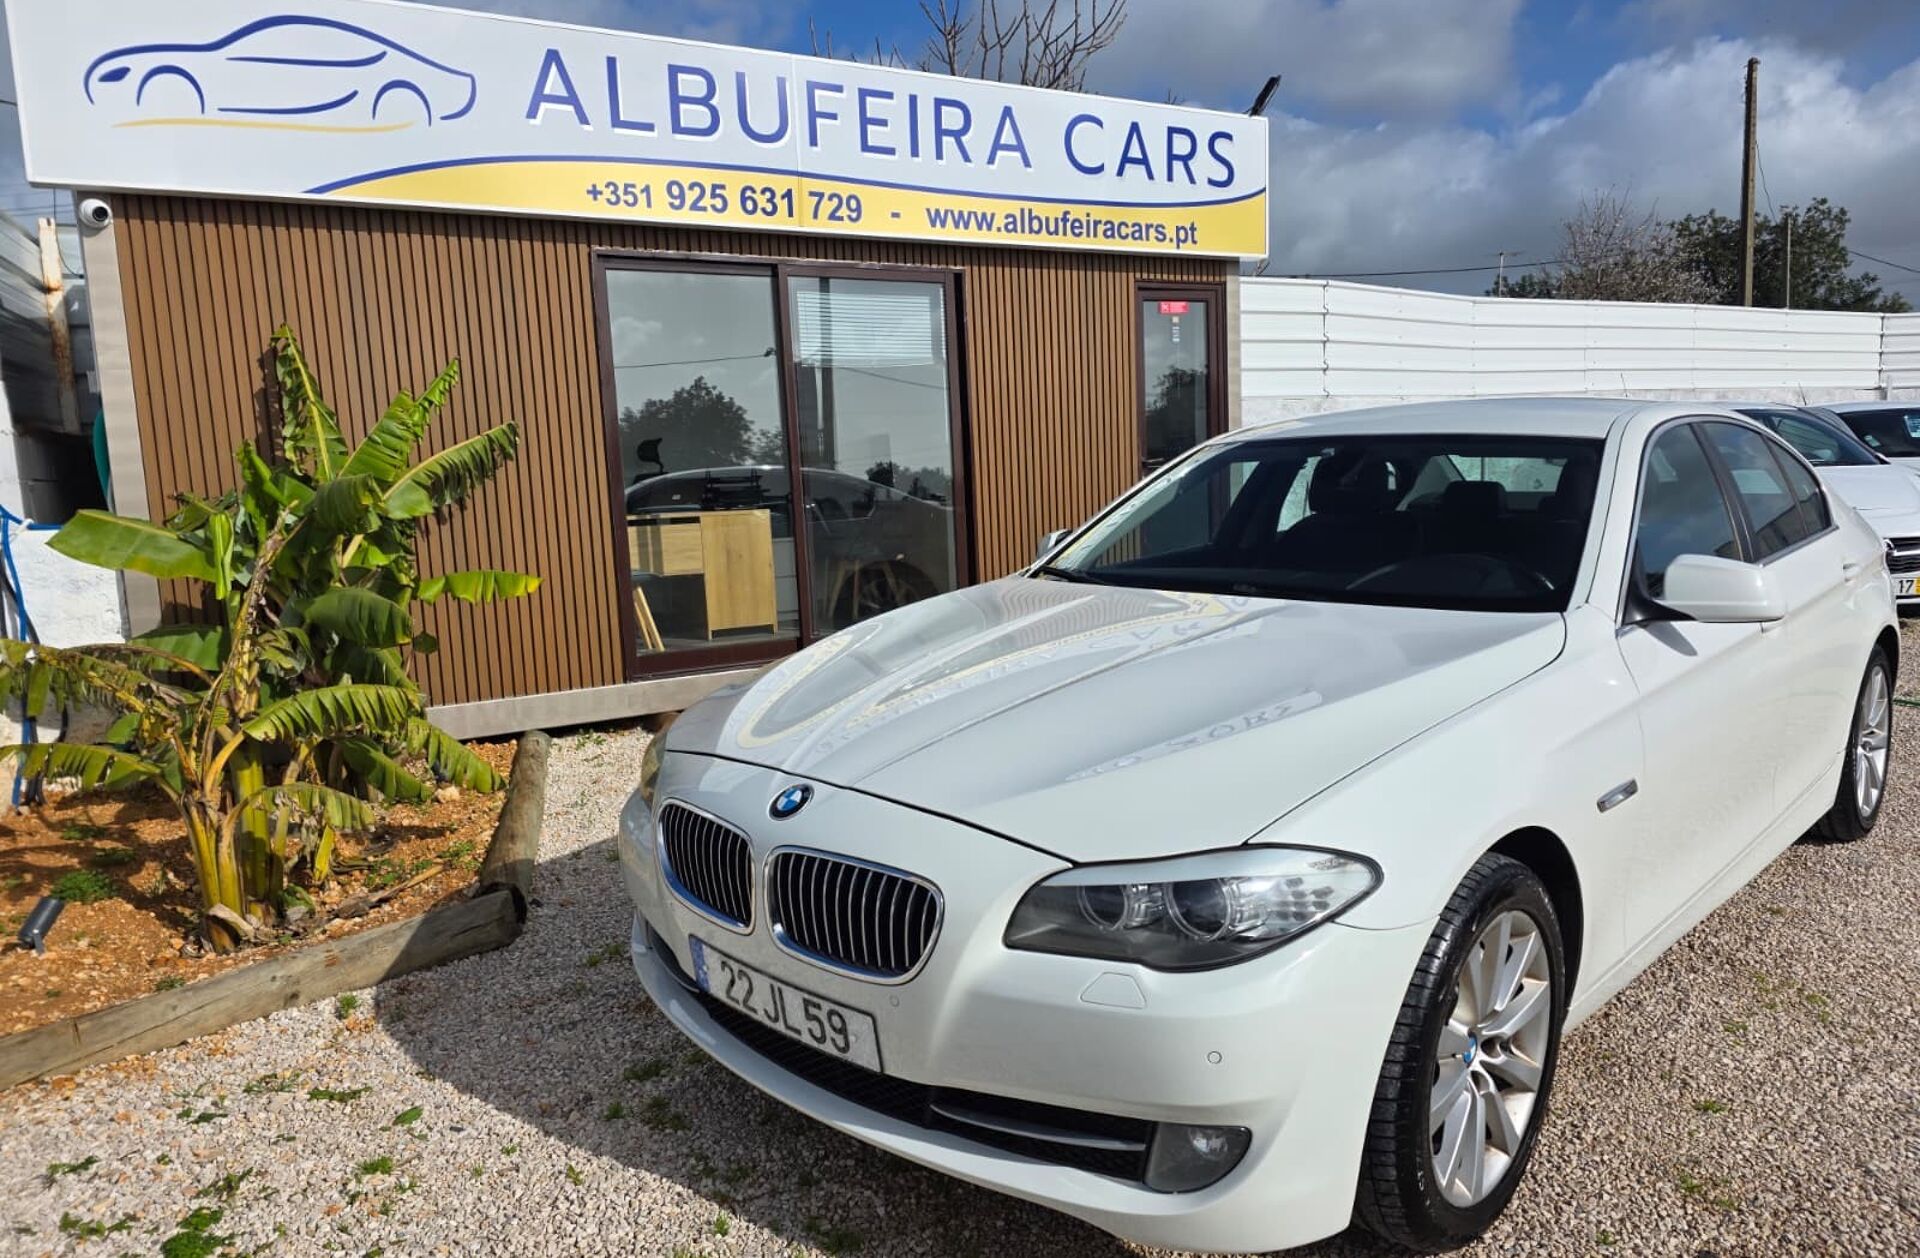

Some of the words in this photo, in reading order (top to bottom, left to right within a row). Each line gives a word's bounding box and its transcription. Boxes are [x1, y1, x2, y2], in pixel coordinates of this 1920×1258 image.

[526, 48, 1032, 169] ALBUFEIRA
[1064, 114, 1235, 188] CARS
[586, 181, 652, 209] +351
[666, 180, 728, 214] 925
[740, 185, 795, 218] 631
[808, 190, 863, 223] 729
[926, 207, 1198, 249] www.albufeiracars.pt
[1899, 580, 1914, 593] 17
